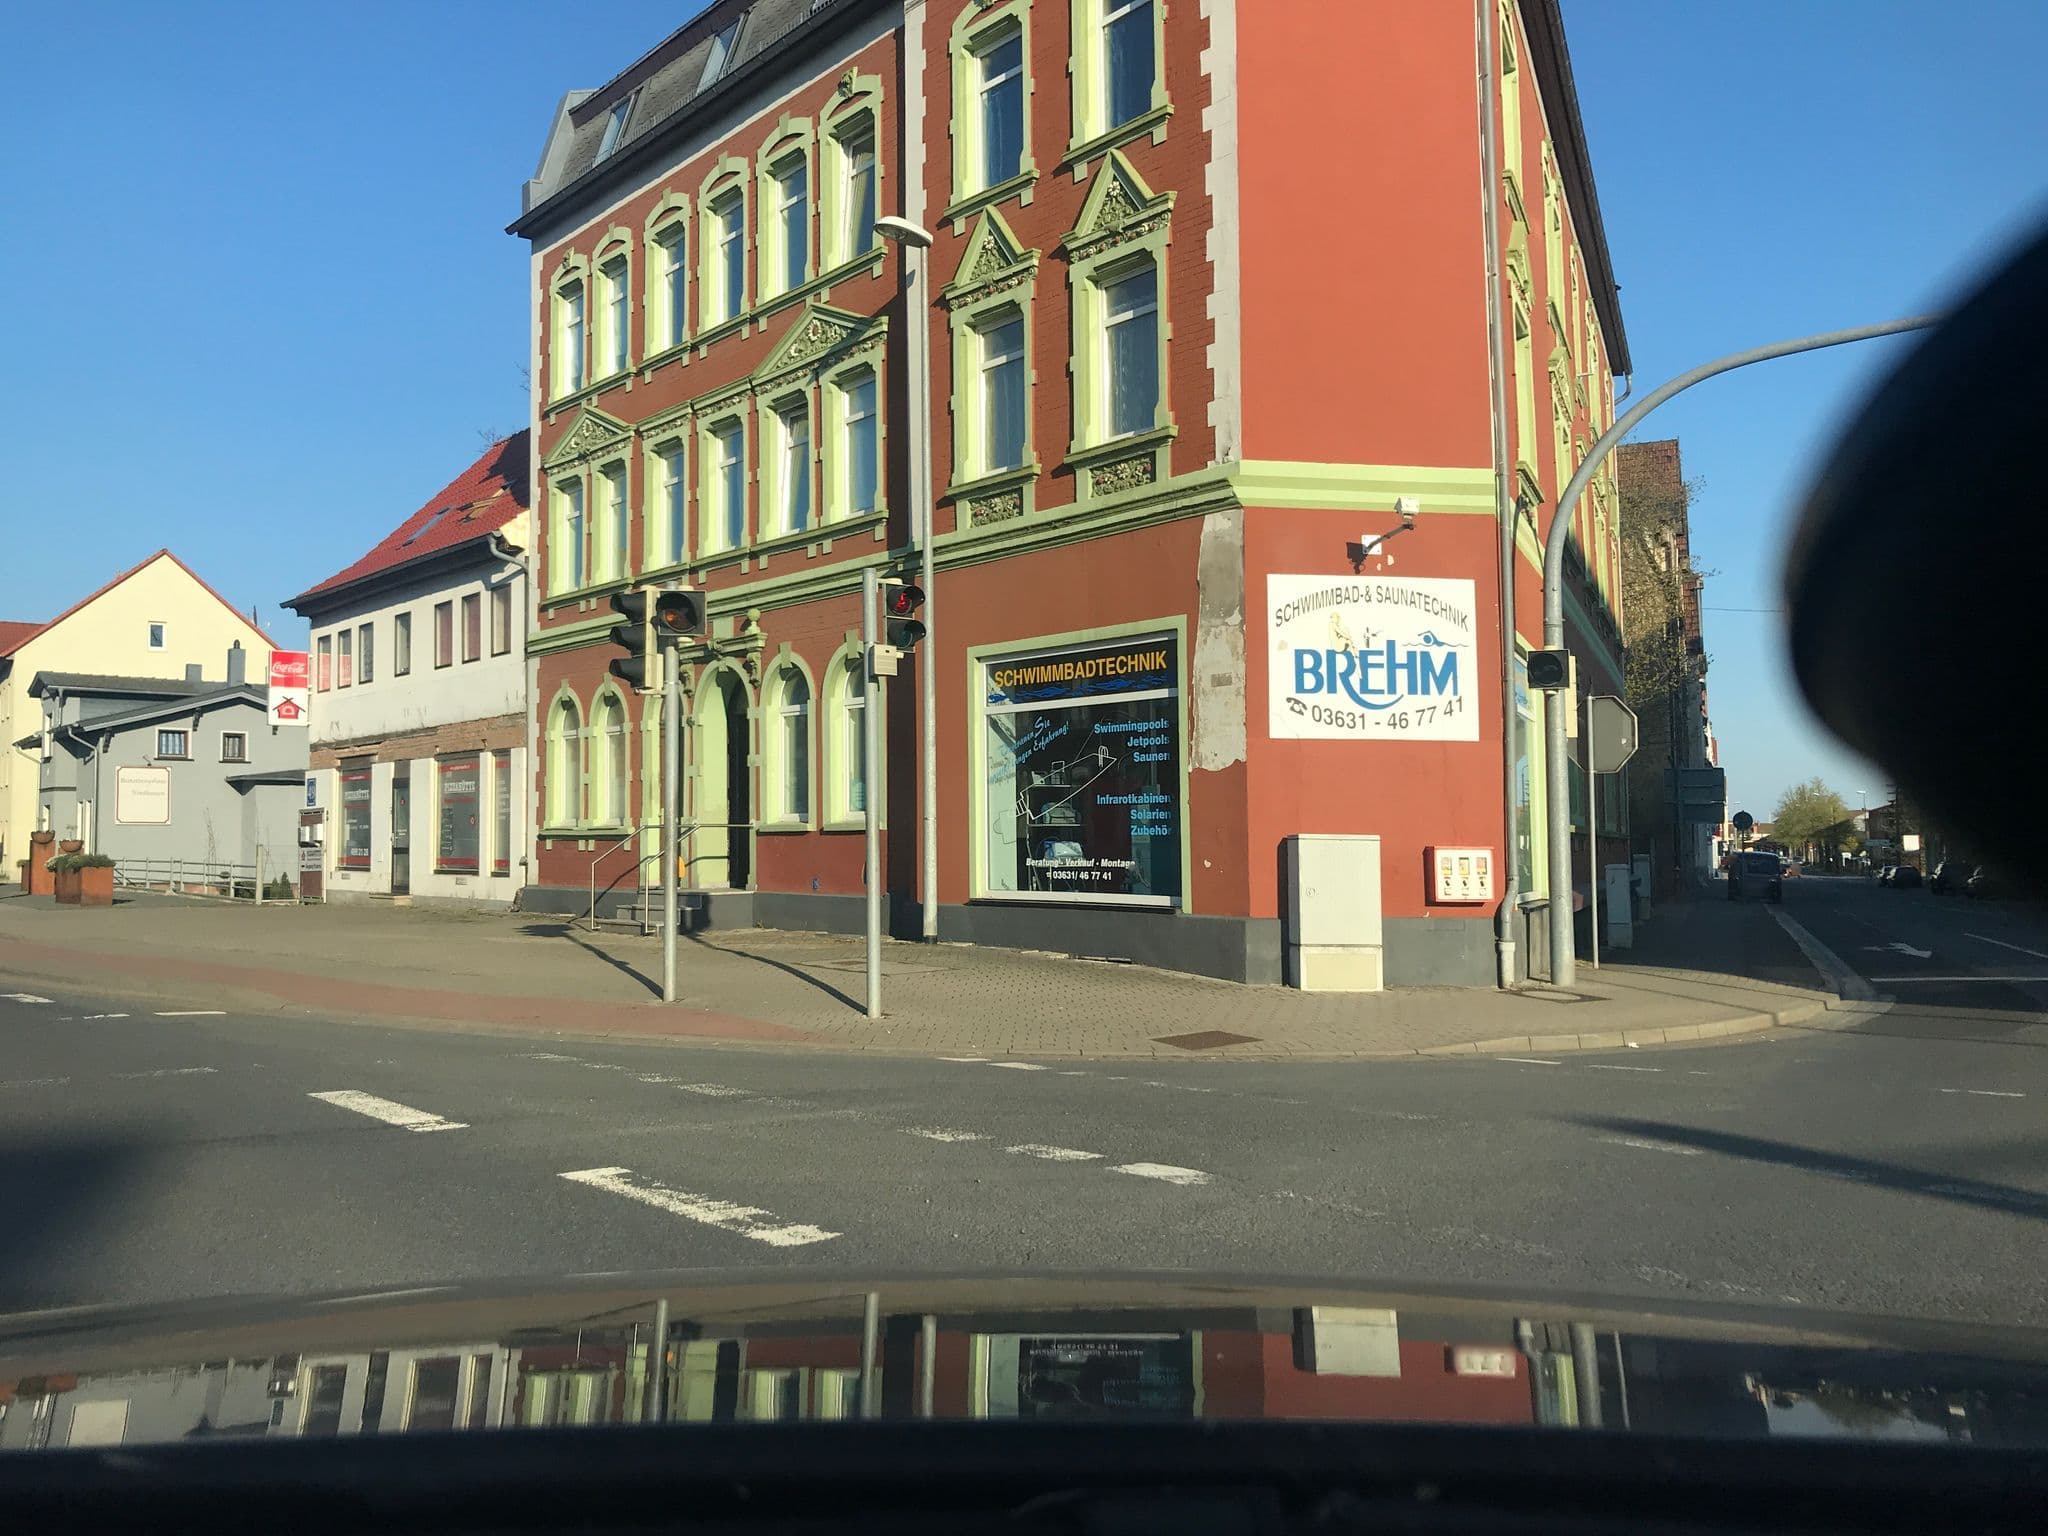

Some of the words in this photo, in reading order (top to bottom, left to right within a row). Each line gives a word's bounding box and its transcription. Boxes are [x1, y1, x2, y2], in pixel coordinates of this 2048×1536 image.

[1375, 585, 1469, 632] SAUNATECHNIK
[994, 650, 1168, 689] SCHWIMMBADTECHNIK
[1294, 639, 1458, 711] BREHM
[1311, 704, 1367, 730] 03631
[1387, 711, 1409, 730] 46
[1415, 705, 1437, 727] 77
[1443, 696, 1464, 718] 41
[1094, 717, 1170, 734] Swimmingpools
[1127, 734, 1170, 748] Jetpools
[1133, 751, 1171, 763] Saunen
[1096, 793, 1171, 805] Infrarotkabinen
[1130, 808, 1171, 820] Solarien
[1100, 858, 1136, 869] Montage
[1079, 871, 1089, 880] 46
[1091, 871, 1101, 880] 77
[1102, 871, 1112, 881] 41
